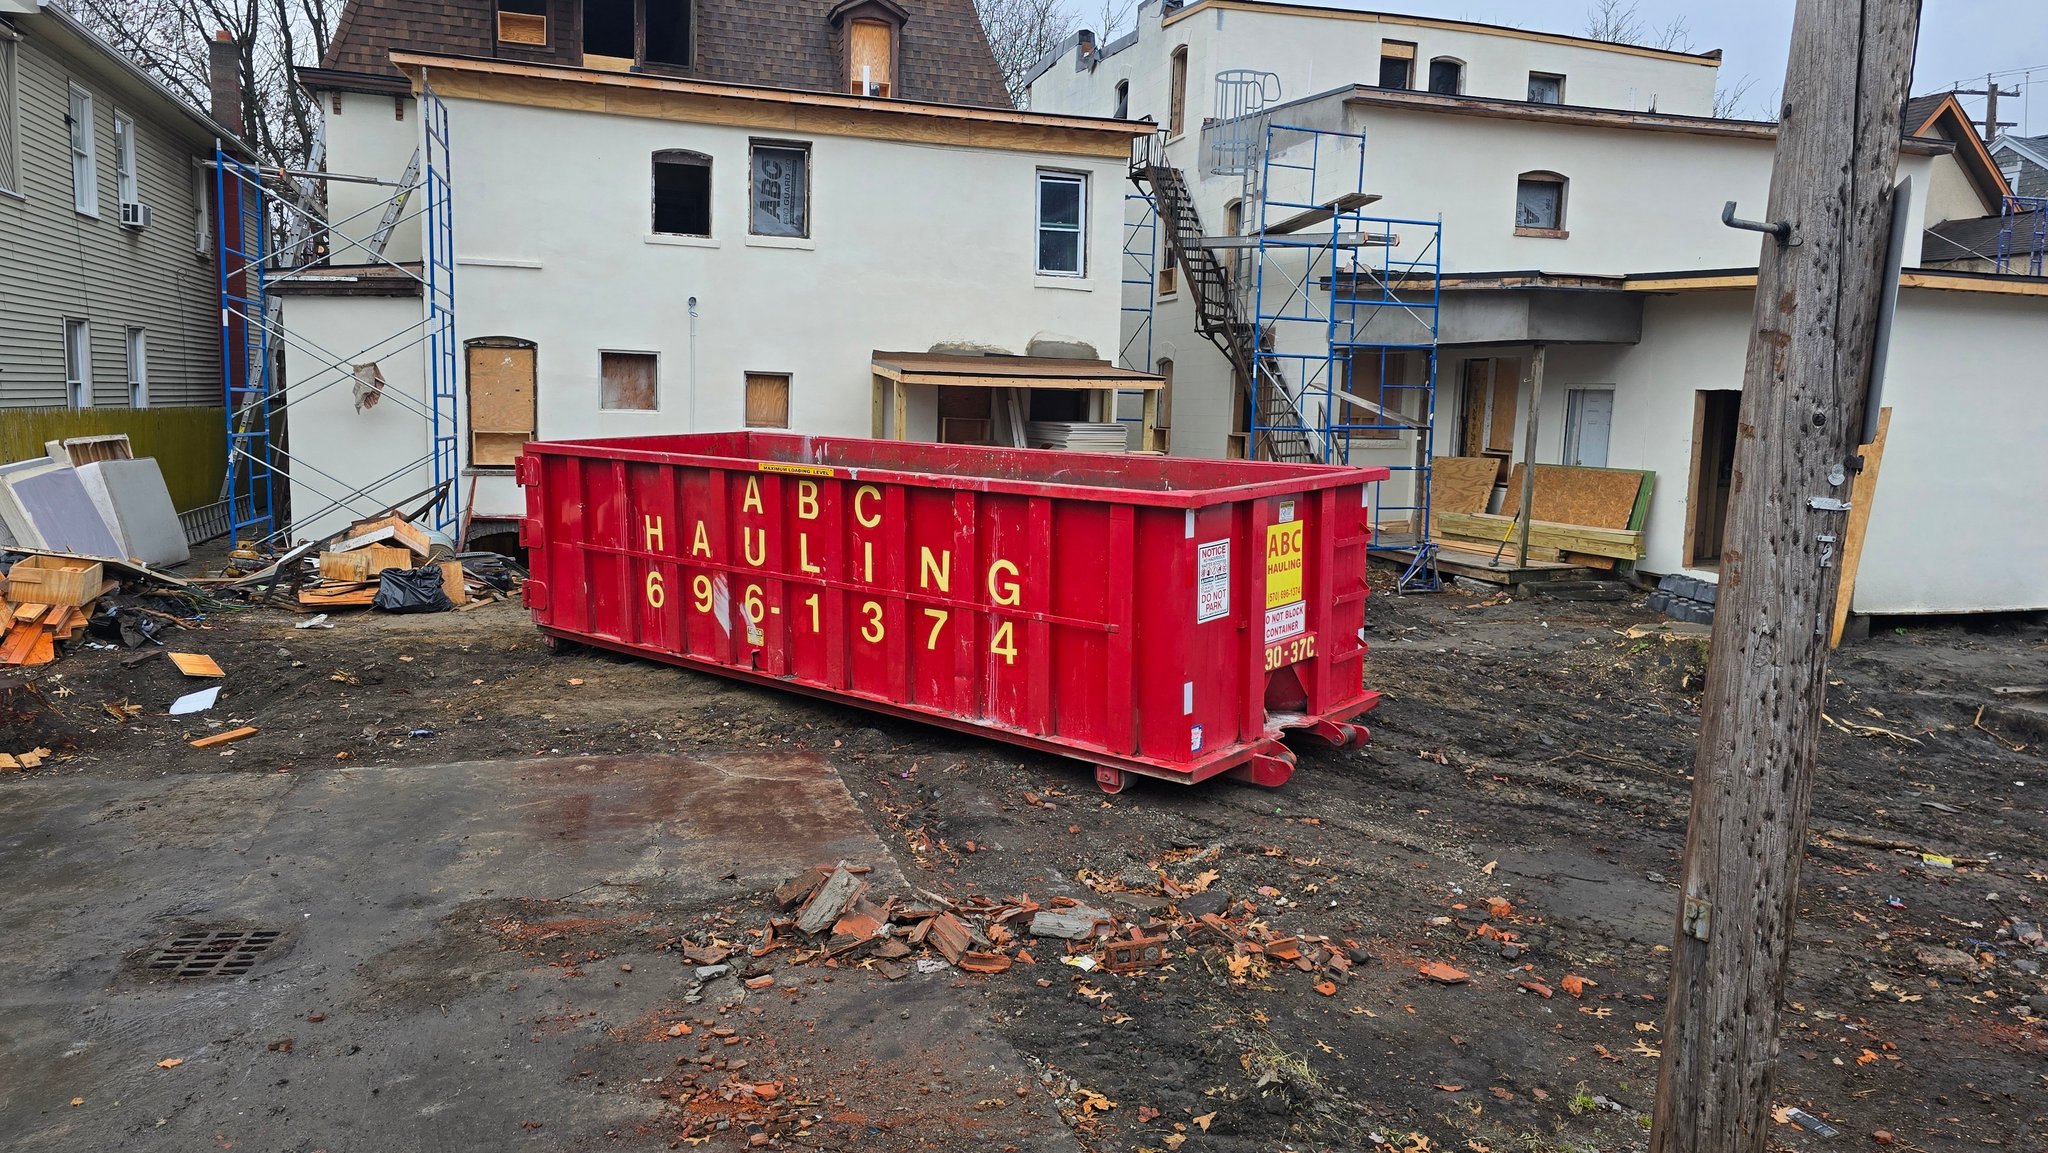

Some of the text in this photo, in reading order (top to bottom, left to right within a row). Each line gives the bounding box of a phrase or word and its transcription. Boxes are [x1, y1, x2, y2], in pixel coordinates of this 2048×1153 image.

[760, 154, 782, 223] ABC
[1202, 545, 1226, 558] NOTICE
[1268, 529, 1301, 558] ABC
[1268, 559, 1301, 574] HAULING
[1201, 589, 1226, 603] DO NOT
[1205, 601, 1222, 612] PARK
[1271, 612, 1284, 622] NOT
[1285, 605, 1303, 618] BLOCK
[1266, 620, 1298, 638] CONTAINER
